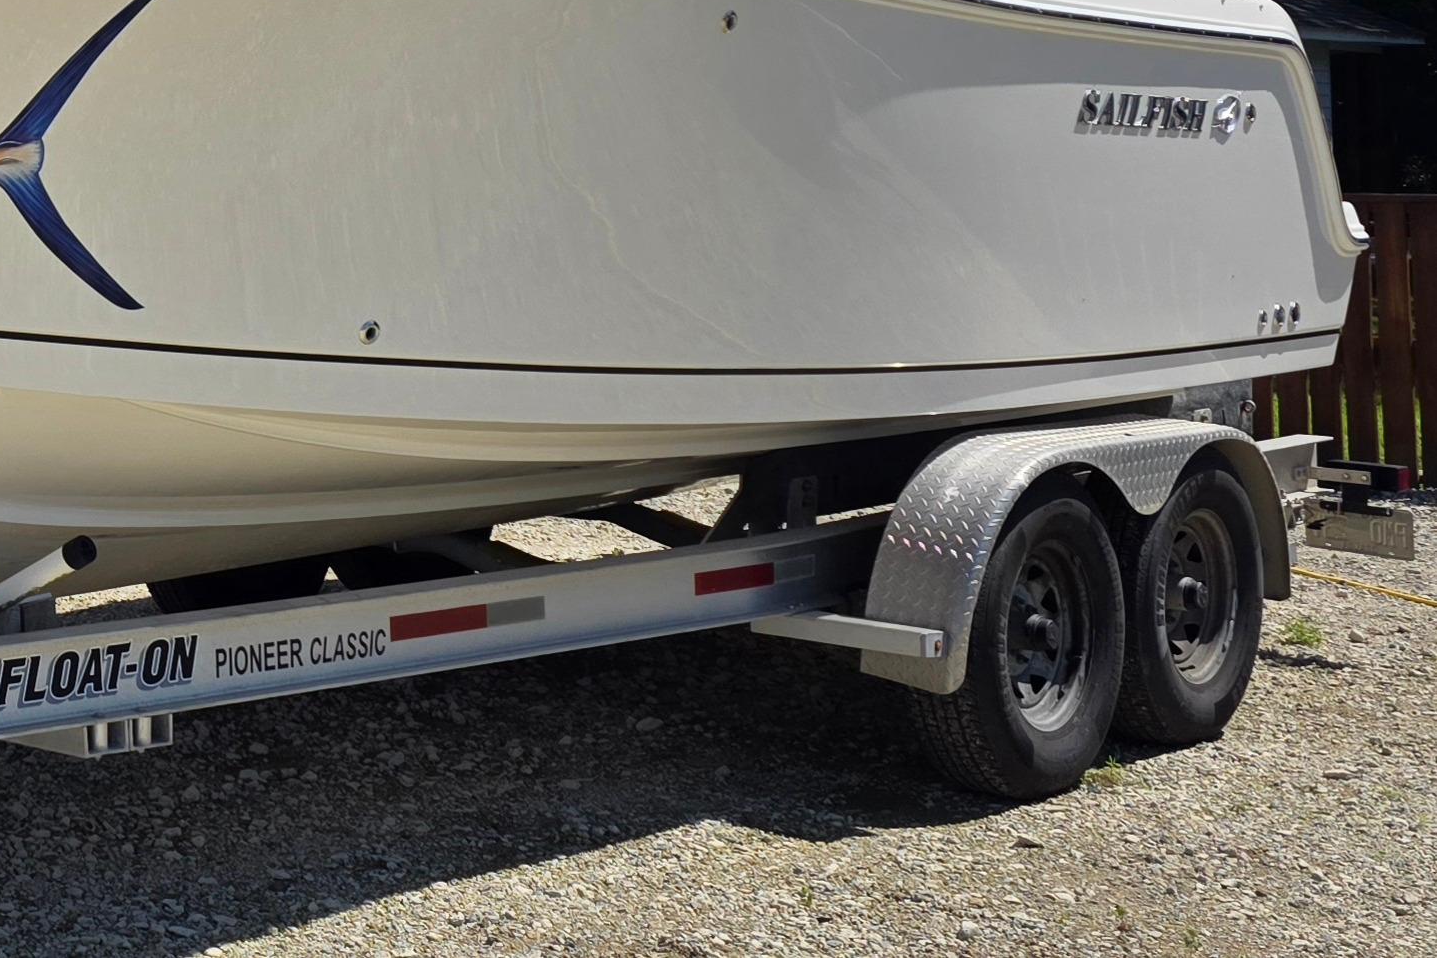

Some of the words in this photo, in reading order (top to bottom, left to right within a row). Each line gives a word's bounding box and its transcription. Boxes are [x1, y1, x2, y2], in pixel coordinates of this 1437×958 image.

[1079, 90, 1208, 132] SAILFISH
[214, 638, 303, 679] PIONEER
[309, 628, 387, 665] CLASSIC
